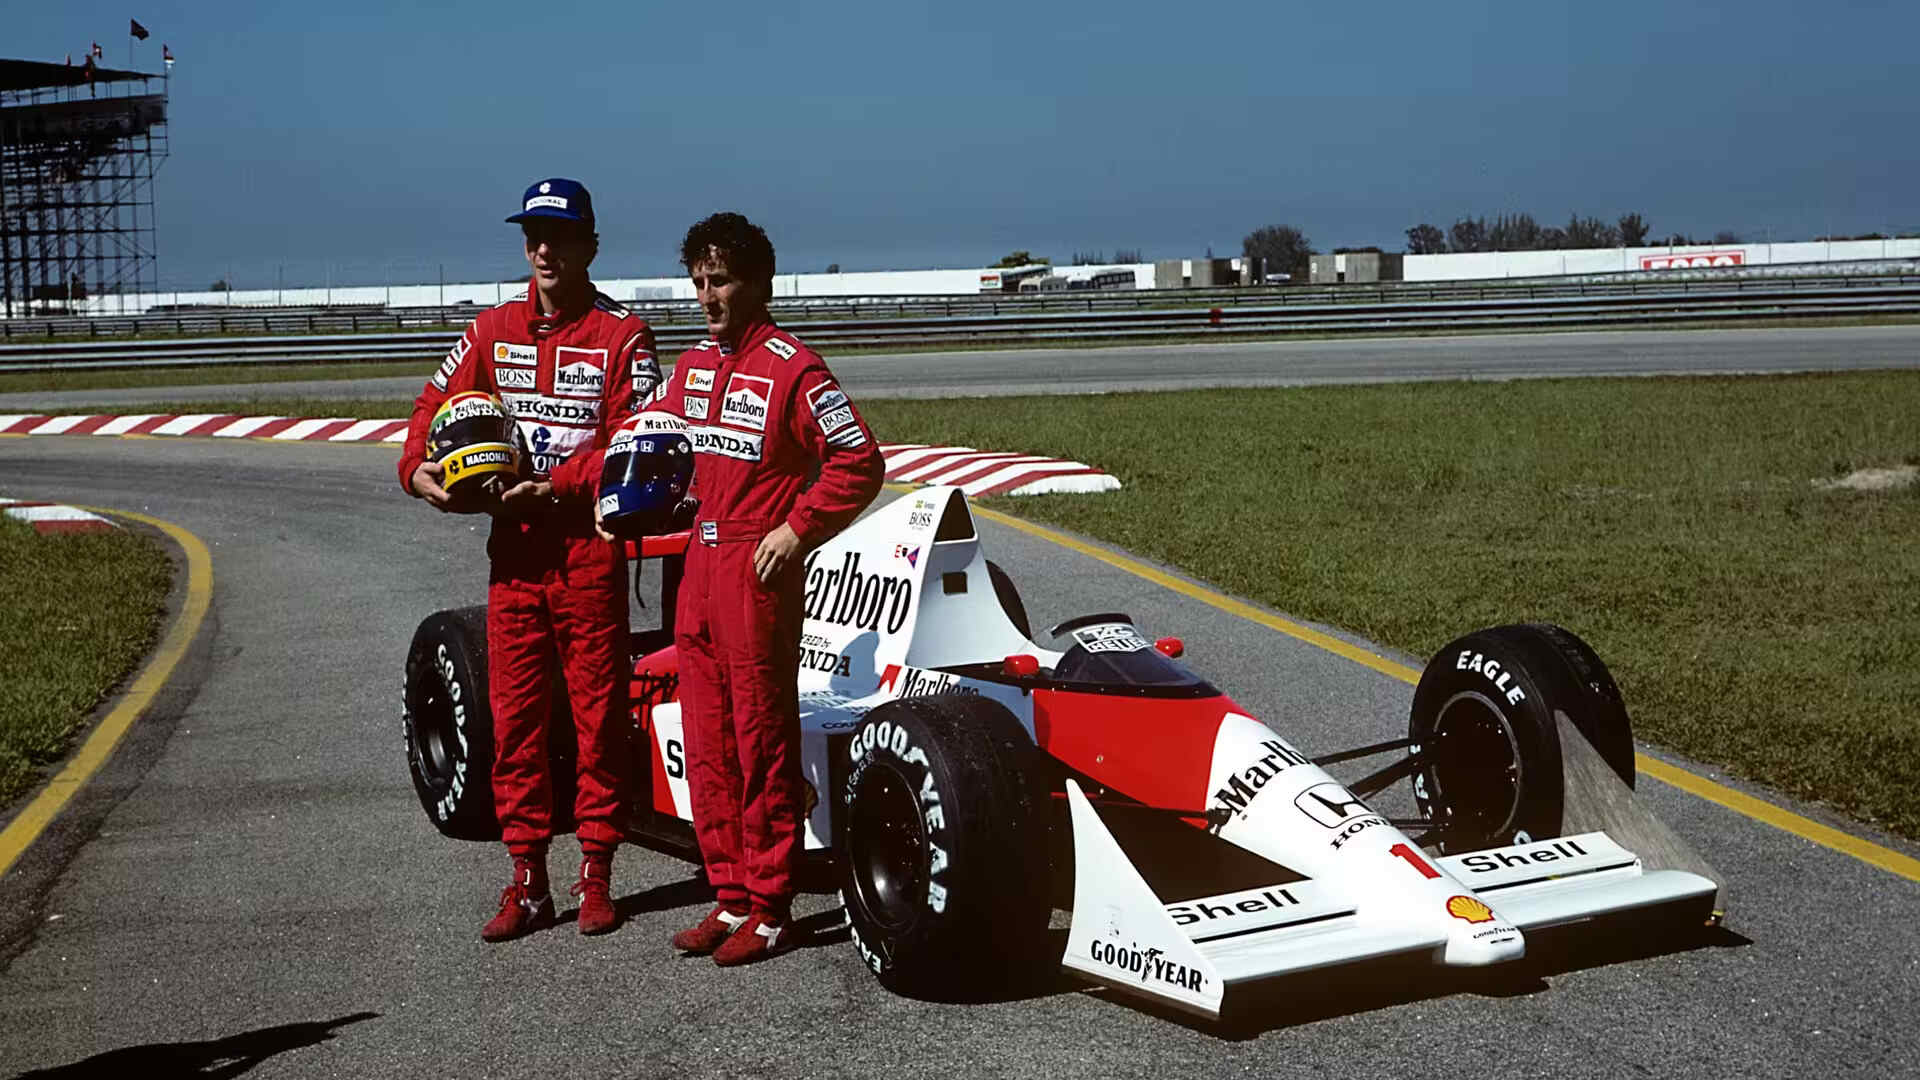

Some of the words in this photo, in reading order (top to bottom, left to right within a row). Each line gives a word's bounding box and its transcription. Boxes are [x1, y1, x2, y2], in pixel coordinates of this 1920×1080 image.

[510, 352, 535, 360] Shell
[498, 369, 533, 385] BOSS
[557, 367, 603, 386] Marlboro
[516, 400, 595, 419] HONDA
[724, 394, 765, 417] Marlboro
[644, 419, 689, 431] Marlbo
[822, 408, 850, 428] BOSS
[465, 451, 510, 466] NACIONAL
[909, 511, 933, 528] BOSS
[799, 647, 851, 677] ONDA
[1456, 650, 1526, 706] EAGLE
[1214, 740, 1311, 816] Marlb
[1330, 817, 1388, 850] HON
[1389, 842, 1442, 880] 1
[1461, 840, 1588, 873] Shell
[1167, 888, 1301, 926] Shell
